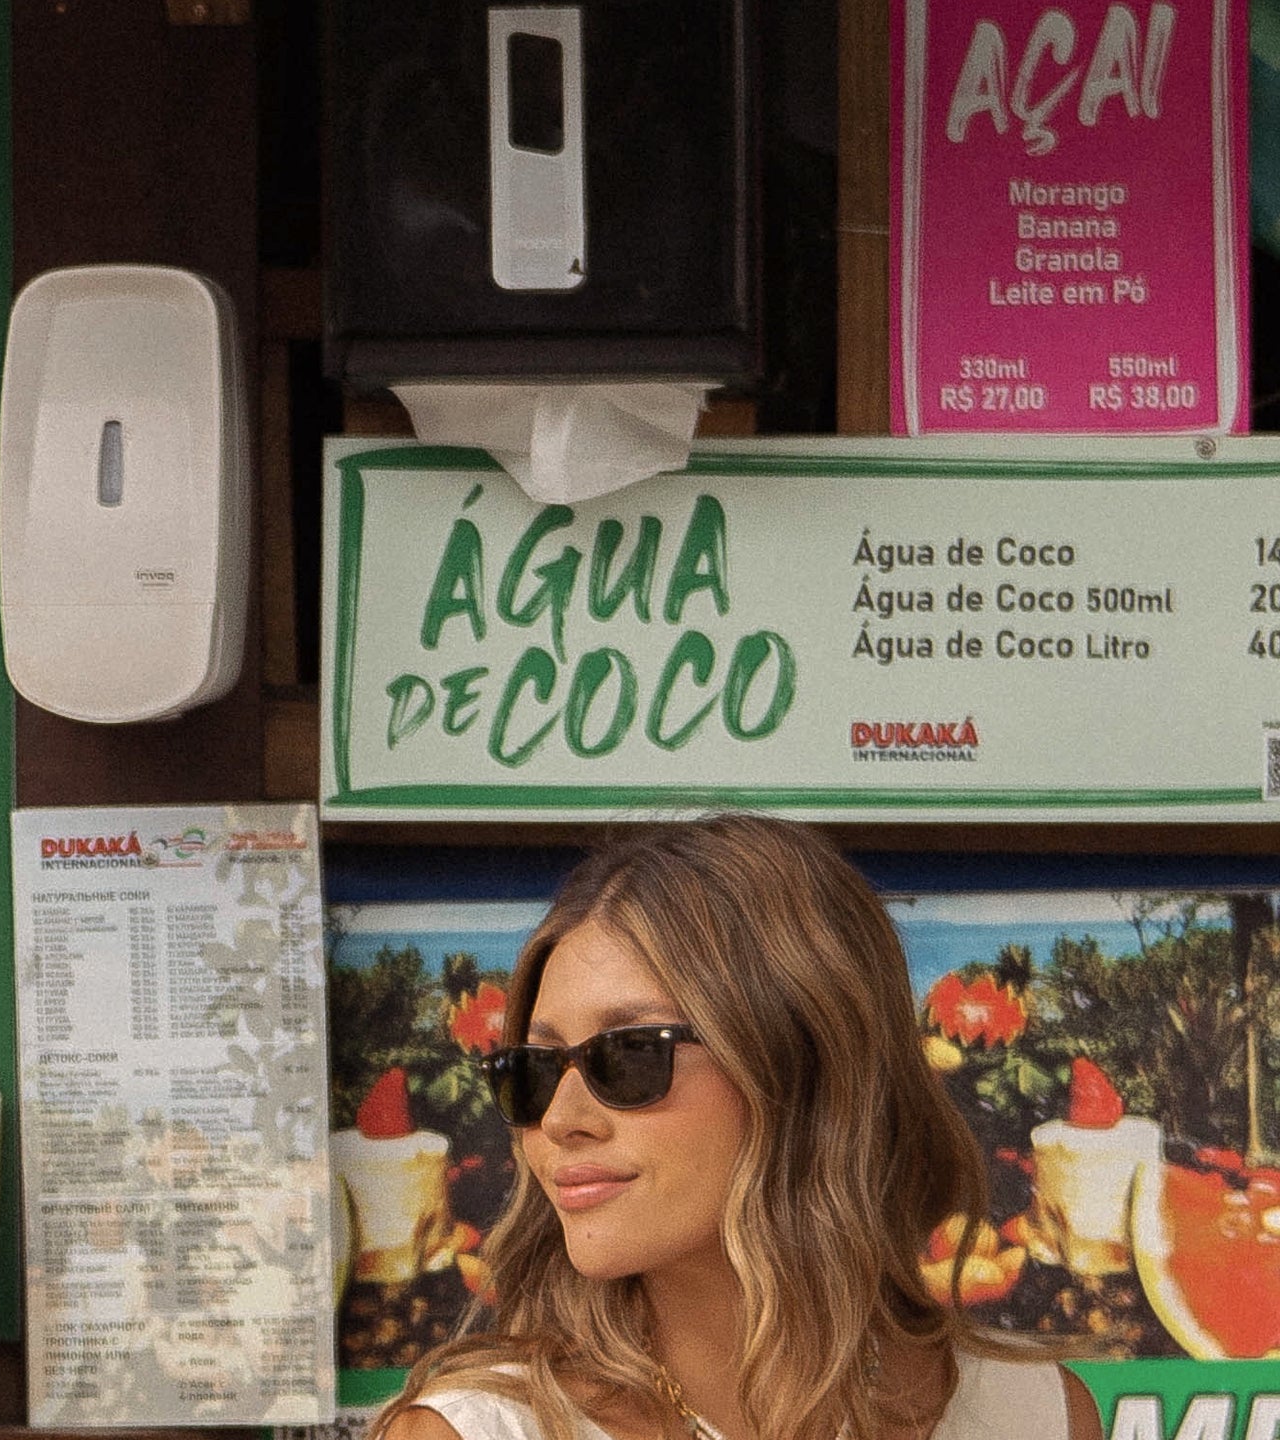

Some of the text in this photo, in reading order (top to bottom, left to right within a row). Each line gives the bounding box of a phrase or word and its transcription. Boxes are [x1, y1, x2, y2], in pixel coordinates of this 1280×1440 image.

[1010, 182, 1125, 211] Morango
[1018, 213, 1118, 239] Banana
[1016, 246, 1120, 272] Granola
[989, 275, 1146, 305] Leite em Pó
[959, 357, 1026, 379] 330ml
[1108, 356, 1176, 378] 550ml
[937, 384, 1045, 413] R$ 27,00
[1089, 383, 1196, 411] R$ 38,00
[853, 527, 1075, 573] Água de Coco
[420, 482, 731, 666] ÁGUA
[852, 574, 1173, 620] Água de Coco 500ml
[385, 629, 798, 769] DE COCO
[851, 716, 979, 749] DUKAKÁ
[853, 749, 977, 762] INTERNACIONAL
[40, 829, 143, 858] DUKAKÁ
